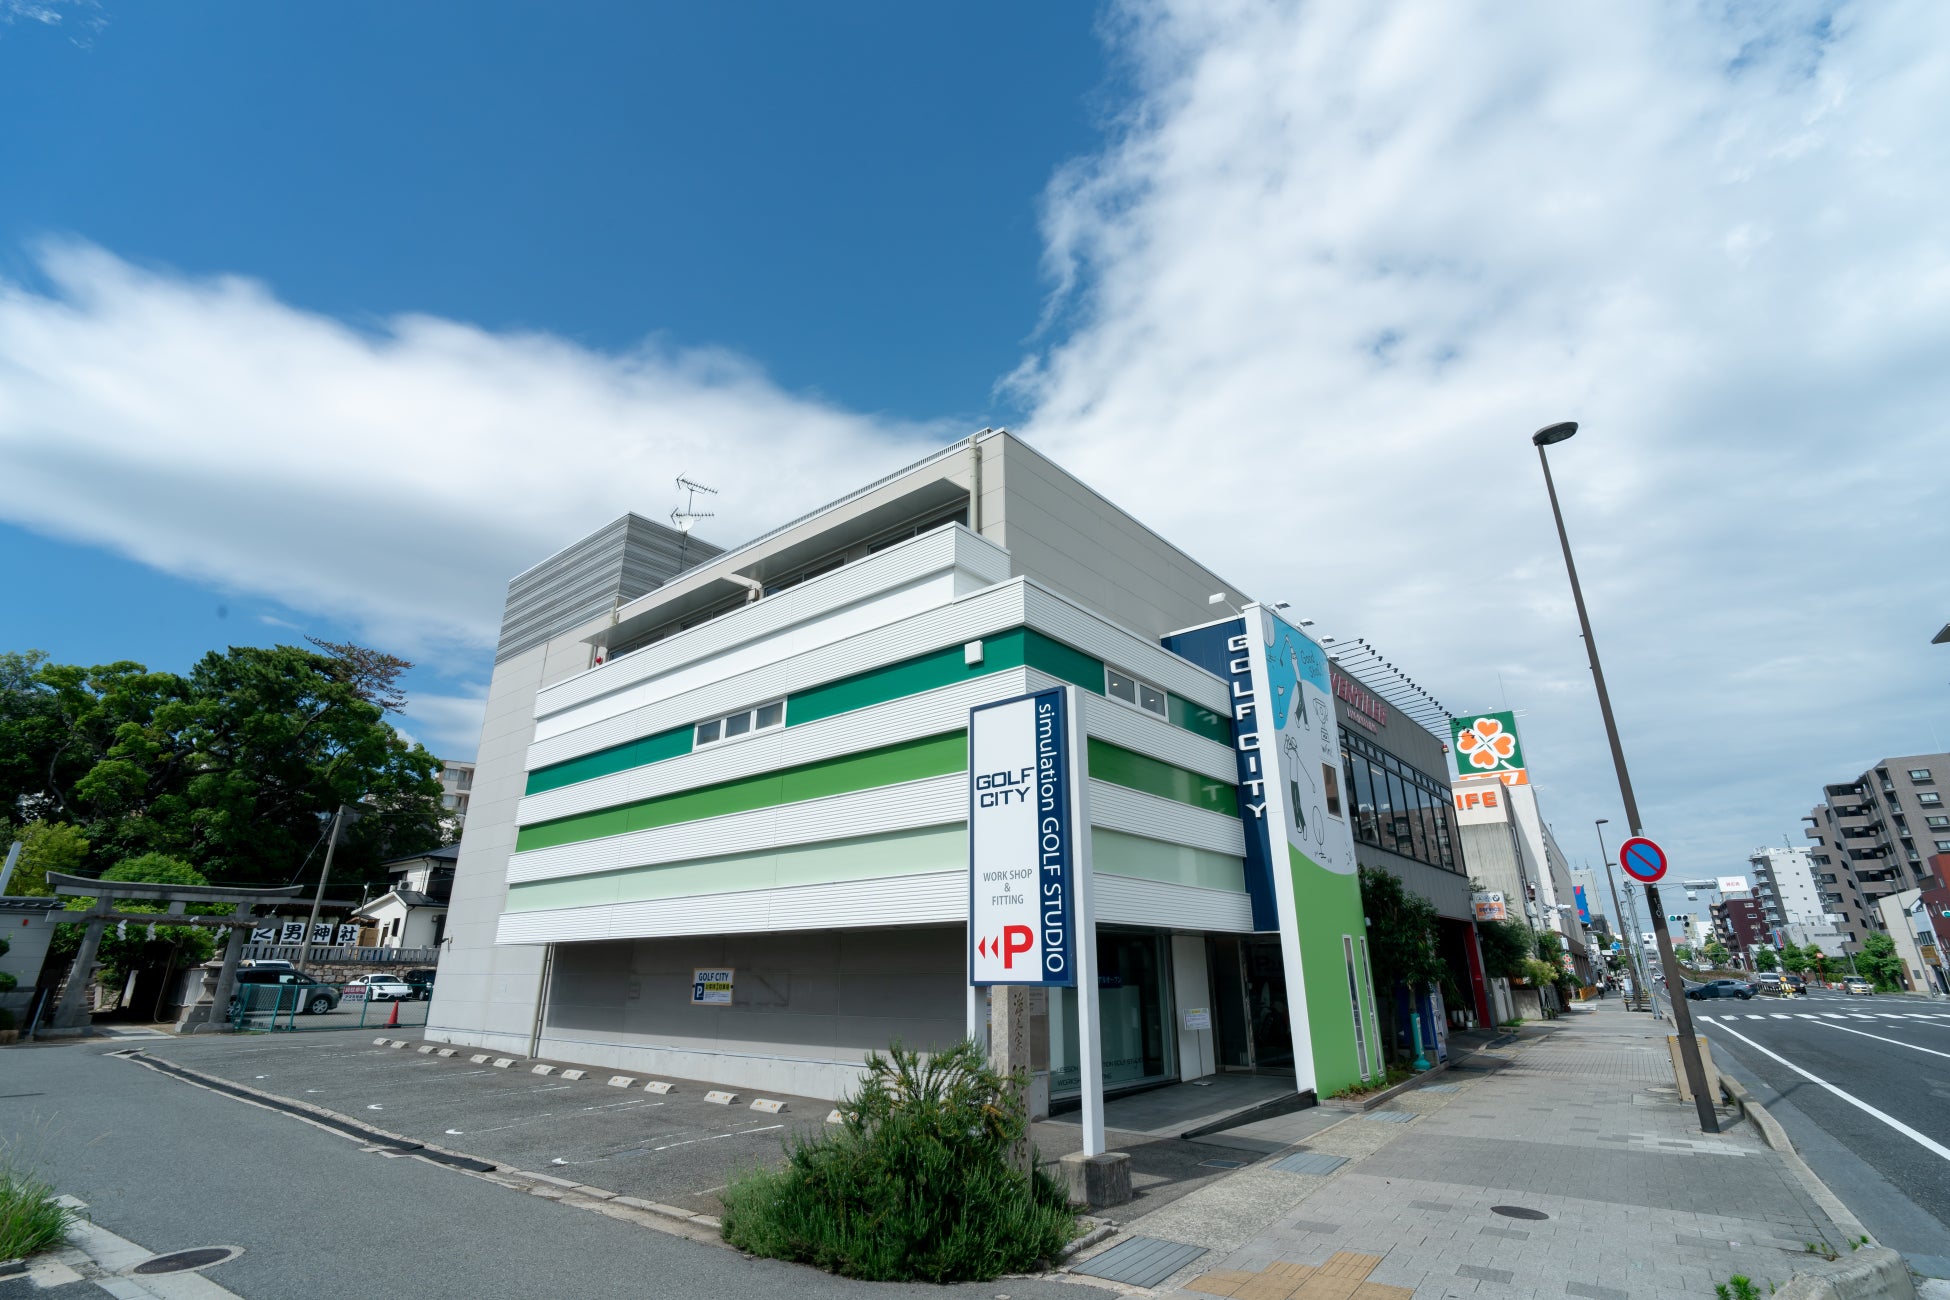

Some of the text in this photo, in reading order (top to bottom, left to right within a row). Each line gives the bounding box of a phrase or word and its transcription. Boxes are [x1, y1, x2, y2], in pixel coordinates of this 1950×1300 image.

[1227, 634, 1267, 819] GOLF CITY
[976, 766, 1035, 791] GOLF
[980, 786, 1031, 808] CITY
[1456, 791, 1497, 809] IFE
[1039, 703, 1064, 973] simulation GOLF STUDIO
[983, 868, 1033, 883] WORK SHOP
[1003, 882, 1011, 893] &
[991, 894, 1024, 906] FITTING
[1003, 924, 1034, 969] P
[698, 972, 729, 981] GOLF CITY
[697, 986, 703, 998] P
